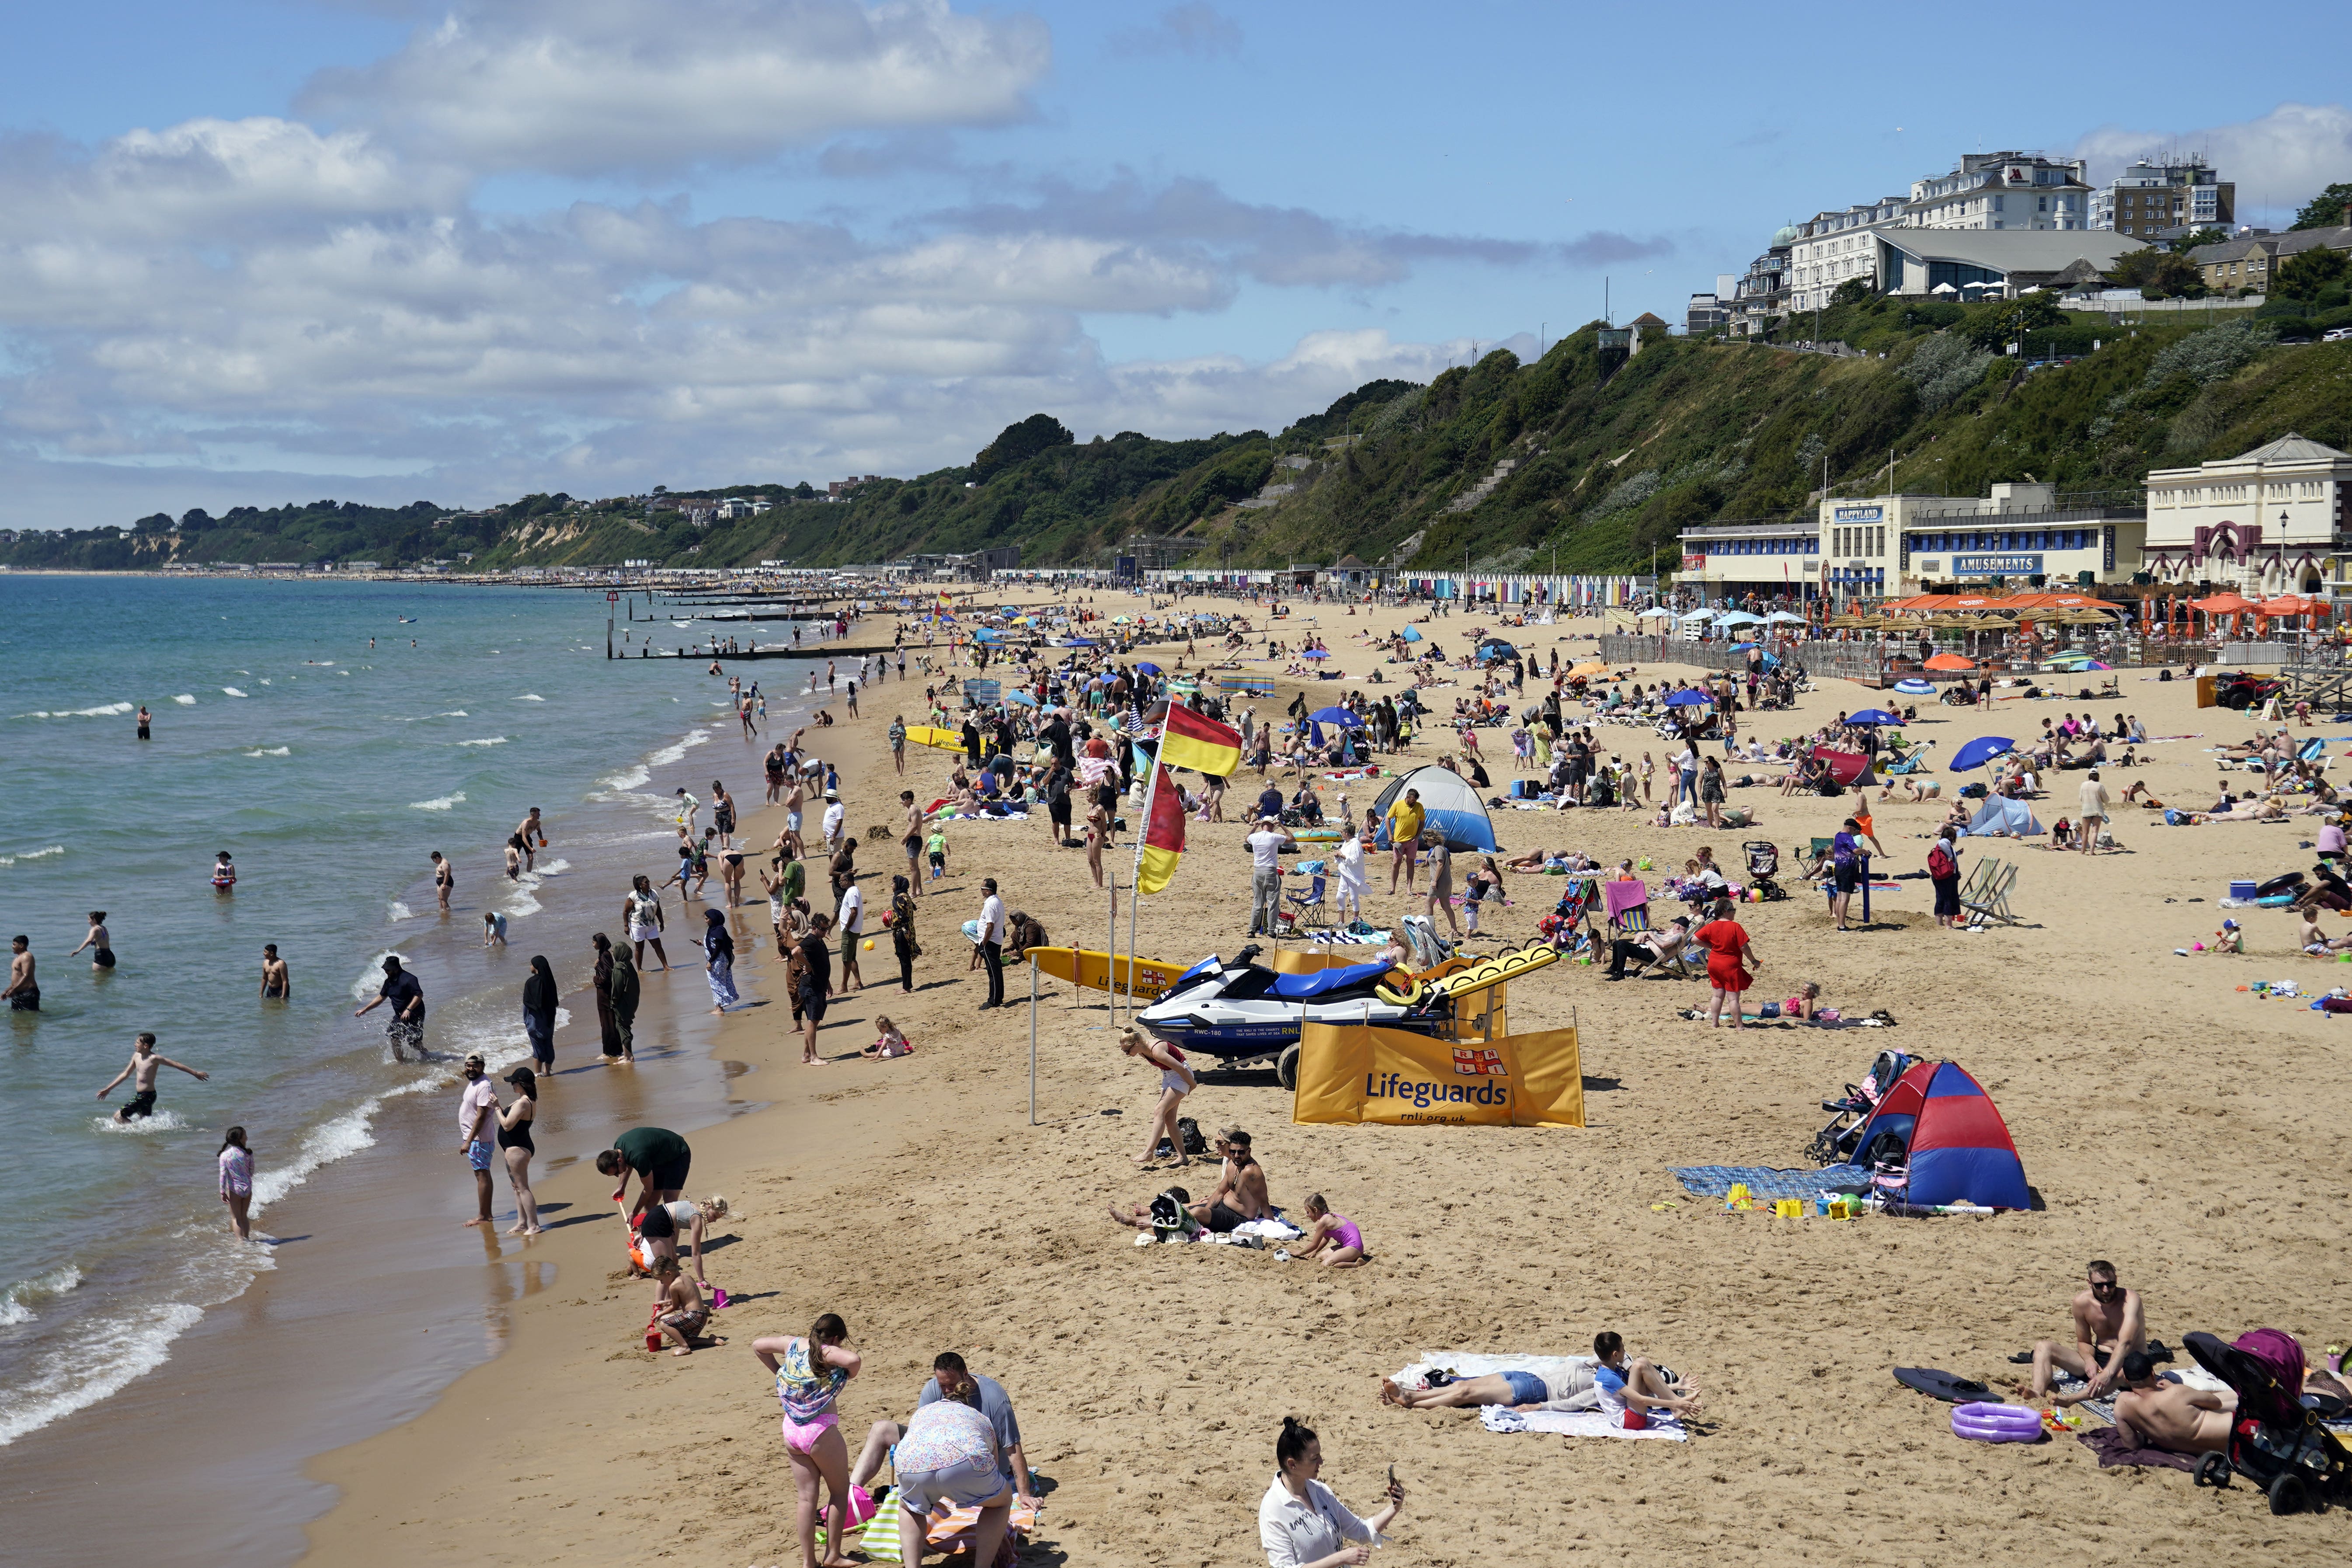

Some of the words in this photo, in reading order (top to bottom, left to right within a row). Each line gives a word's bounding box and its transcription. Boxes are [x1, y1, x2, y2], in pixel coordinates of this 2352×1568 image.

[1839, 509, 1878, 520] HAPPYLAND
[1960, 558, 2034, 571] AMUSEMENTS
[1366, 1073, 1507, 1108] Lifeguards
[1401, 1113, 1466, 1123] rnli.org.uk
